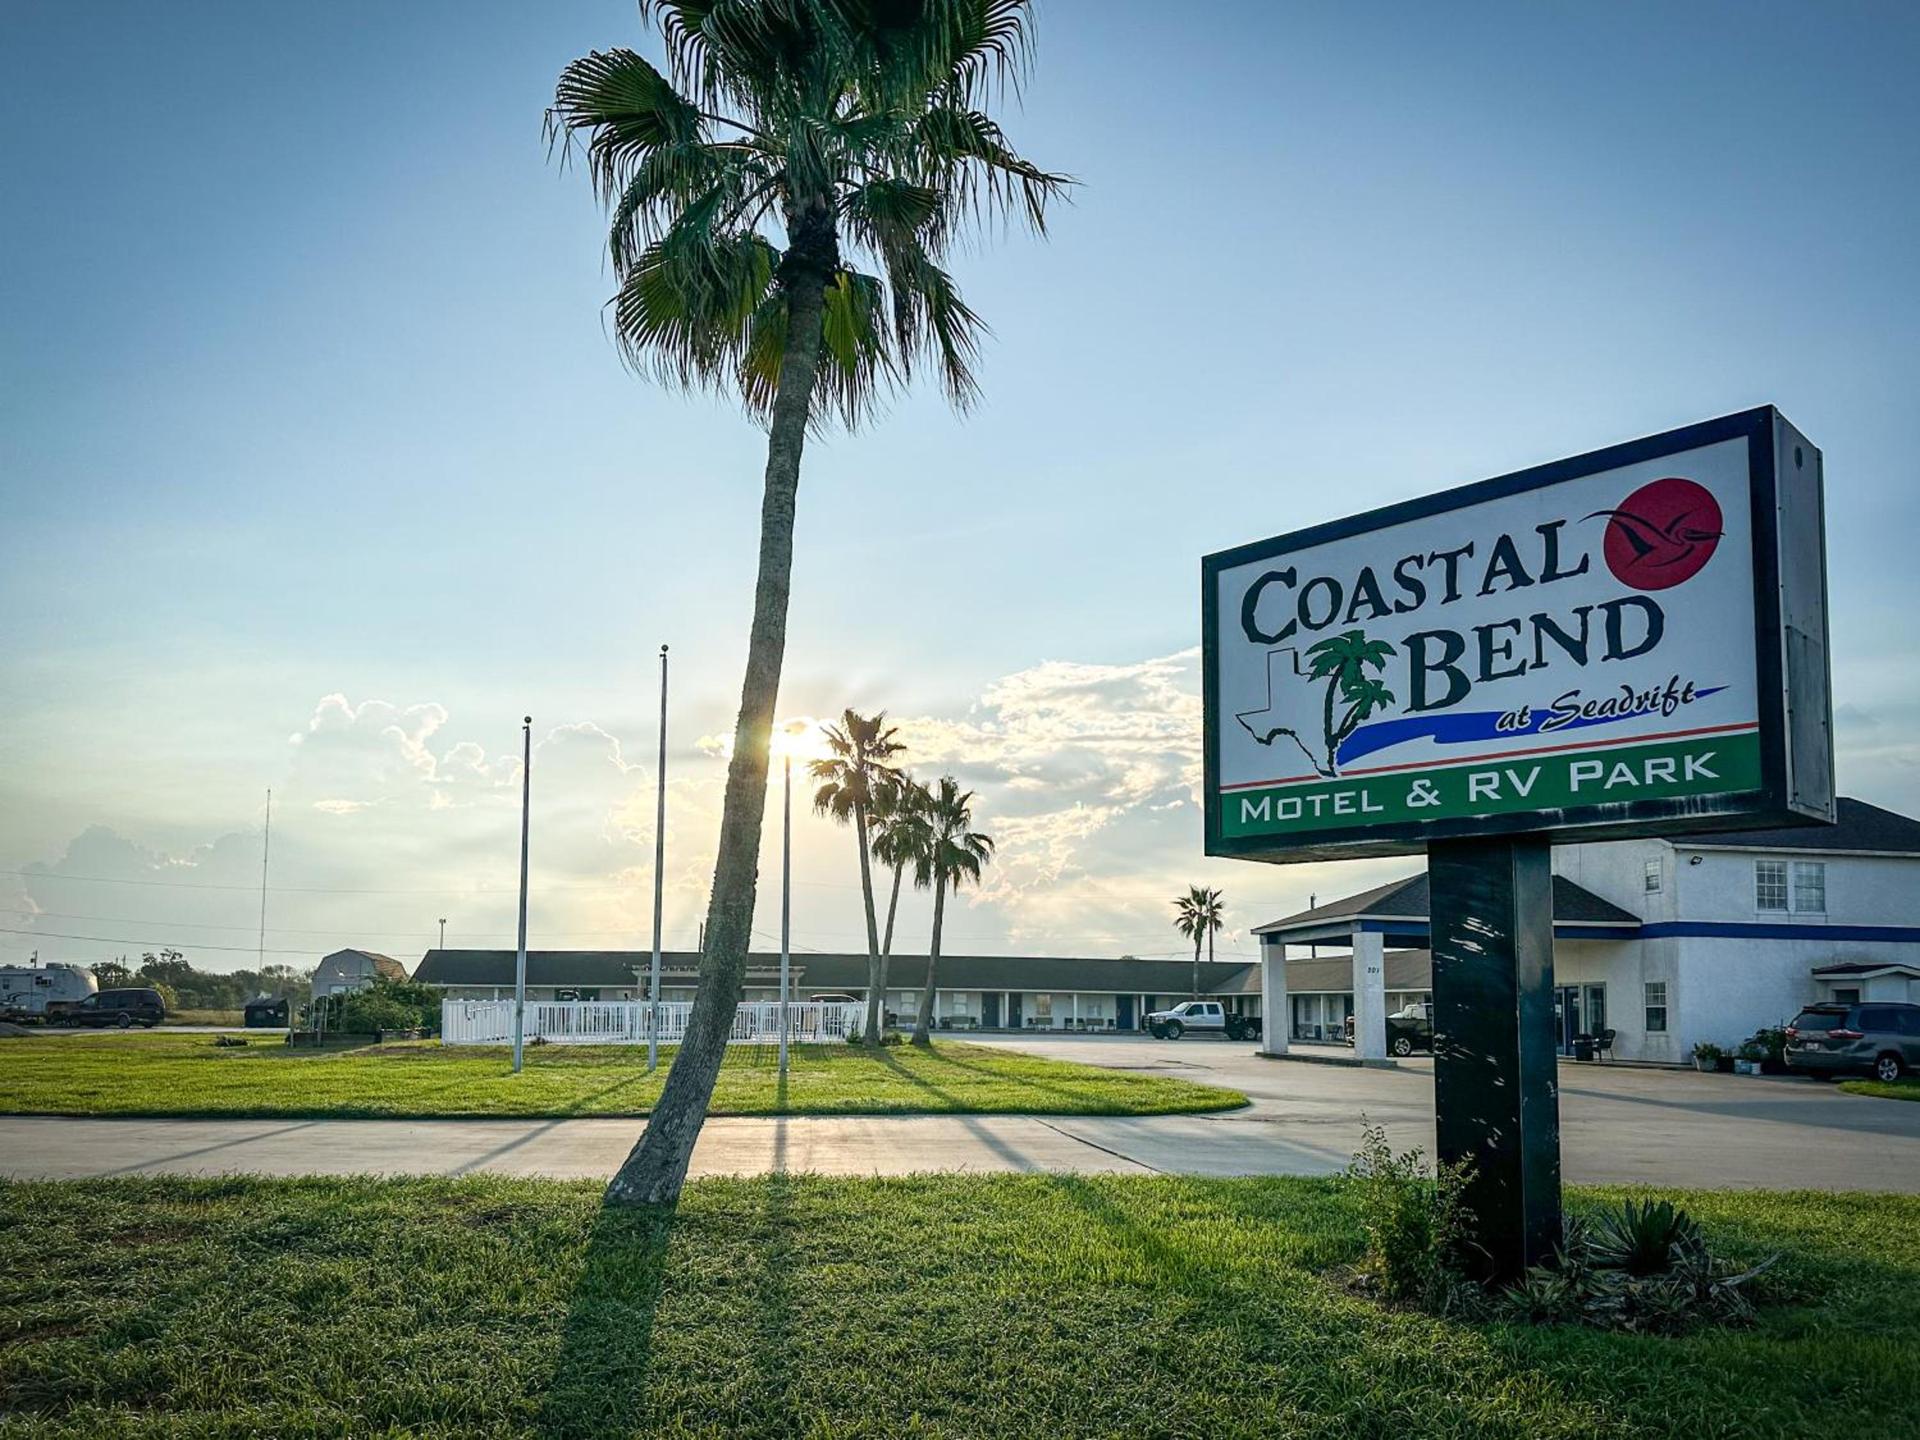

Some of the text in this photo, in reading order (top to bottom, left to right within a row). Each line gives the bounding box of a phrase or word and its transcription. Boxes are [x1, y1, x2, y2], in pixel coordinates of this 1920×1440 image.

[1241, 519, 1589, 645] COASTAL
[1402, 594, 1666, 712] BEND
[1496, 675, 1697, 733] at Seadrift
[1240, 751, 1721, 824] MOTEL & RV PARK
